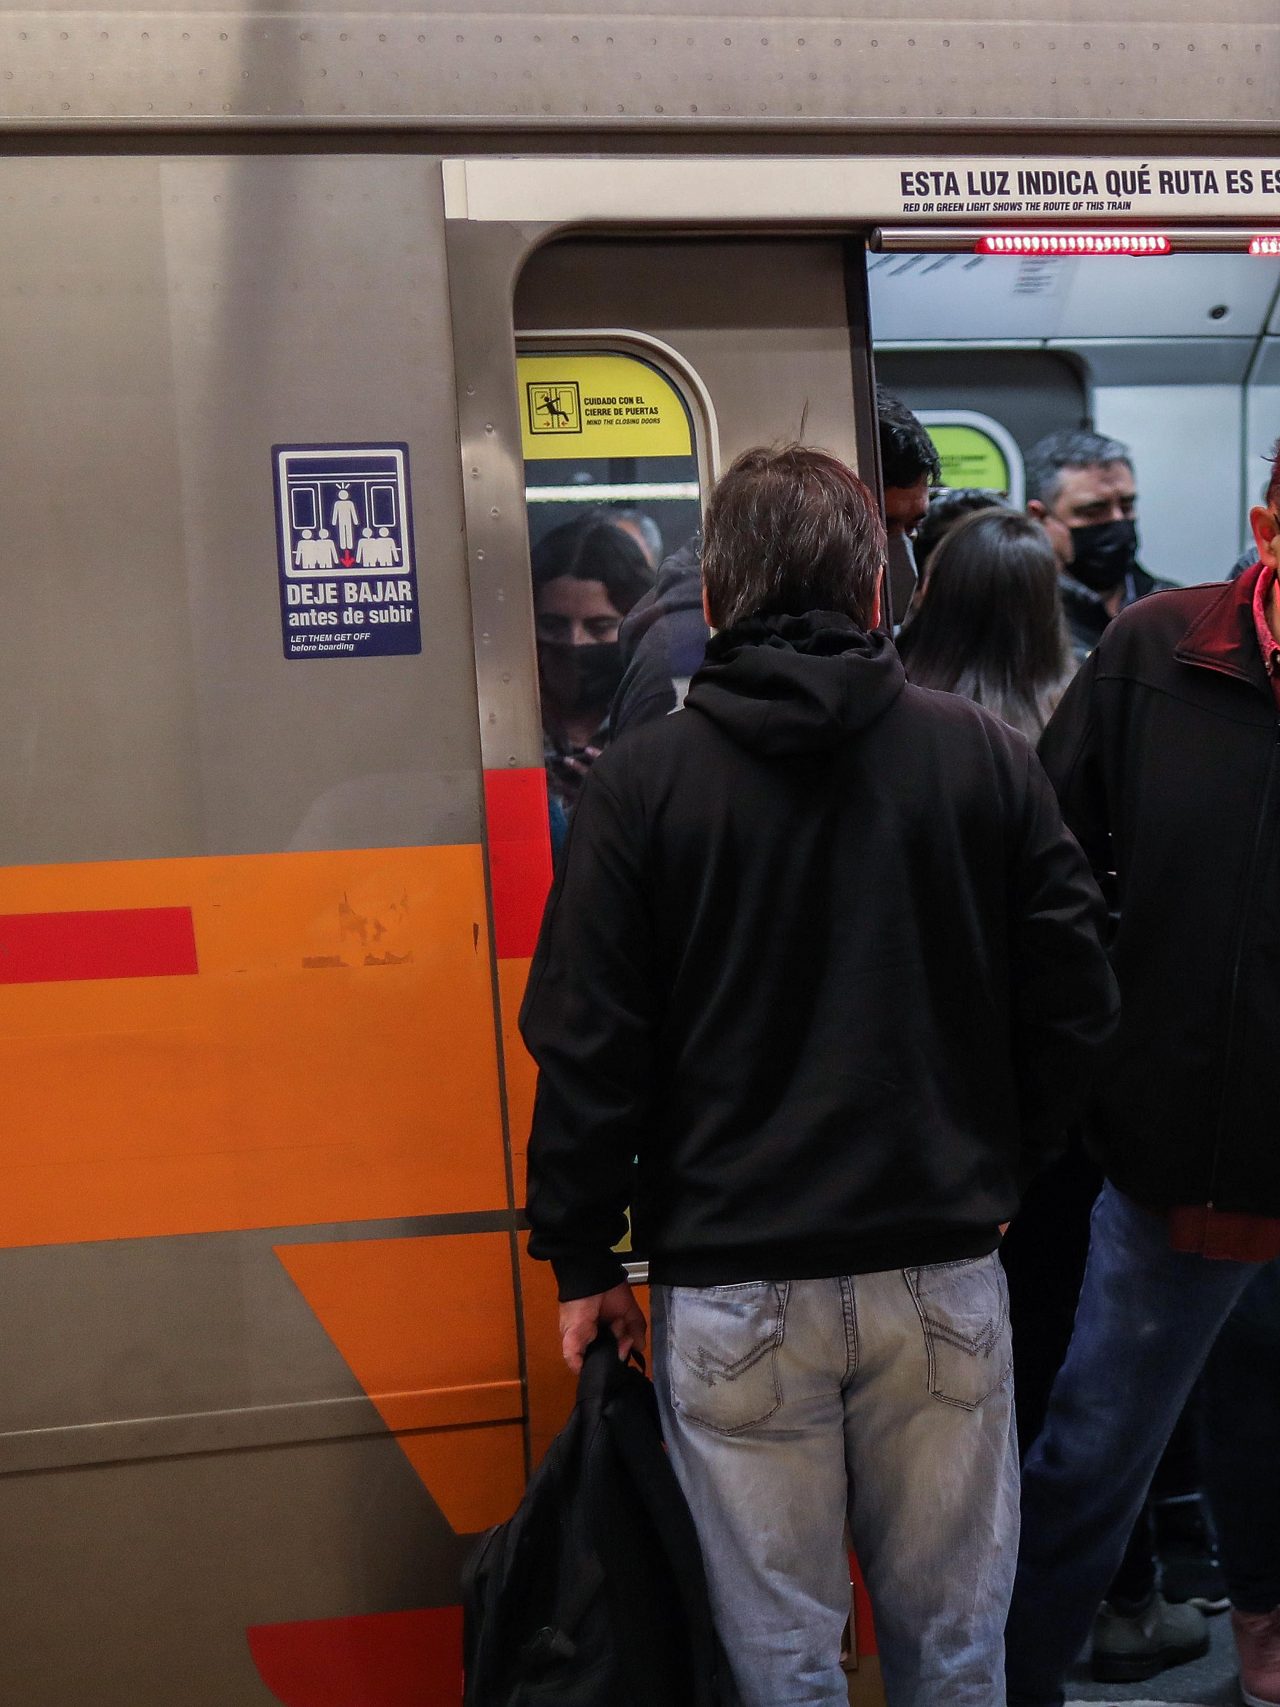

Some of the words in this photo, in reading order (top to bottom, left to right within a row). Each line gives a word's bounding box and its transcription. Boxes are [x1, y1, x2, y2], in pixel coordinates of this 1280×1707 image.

[900, 171, 960, 196] ESTA
[967, 170, 1010, 196] LUZ
[1017, 170, 1099, 196] INDICA
[1105, 163, 1151, 198] QUÉ
[1158, 170, 1219, 195] RUTA
[1225, 169, 1253, 194] ES
[903, 202, 920, 213] RED
[922, 202, 934, 212] OR
[936, 202, 964, 212] GREEN
[966, 202, 991, 212] LIGHT
[992, 201, 1023, 212] SHOWS
[1025, 201, 1041, 212] THE
[1043, 201, 1070, 211] ROUTE
[1072, 201, 1084, 211] OF
[1086, 201, 1105, 211] THIS
[1107, 201, 1132, 211] TRAIN
[583, 397, 617, 406] CUIDADO
[618, 396, 634, 405] CON
[636, 396, 645, 404] EL
[585, 408, 611, 416] CIERRE
[626, 407, 659, 415] PUERTAS
[286, 582, 338, 605] DEJE
[344, 580, 413, 603] BAJAR
[288, 608, 338, 627] antes
[343, 606, 365, 624] de
[369, 605, 413, 624] subir
[290, 635, 307, 643] LET
[308, 634, 332, 642] THEM
[333, 633, 352, 641] GET
[353, 632, 371, 640] OFF
[291, 644, 317, 652] before
[318, 642, 355, 652] boarding
